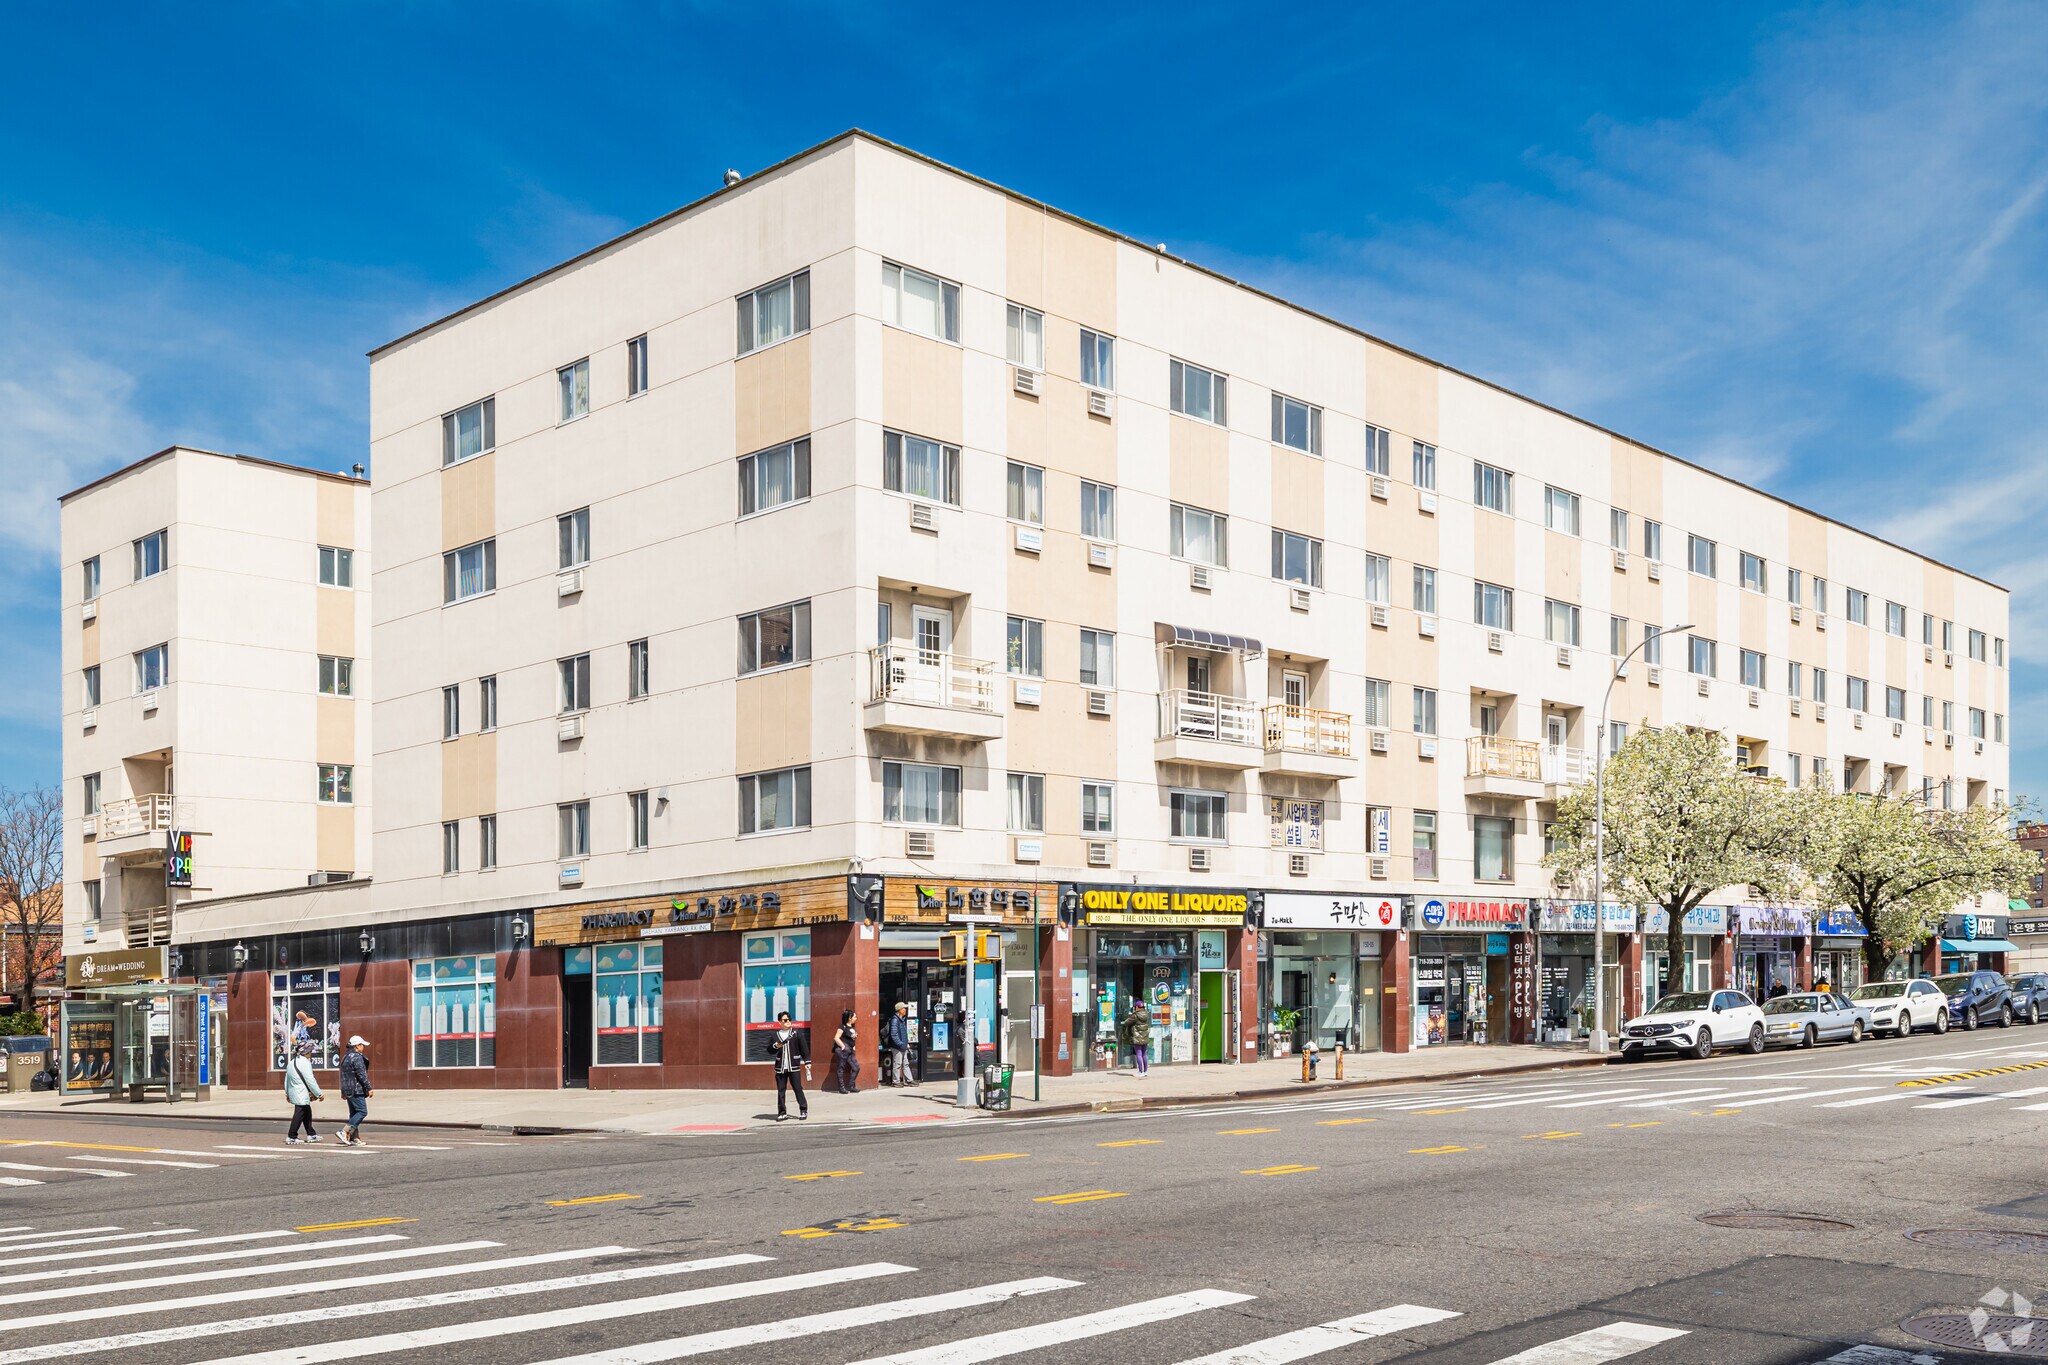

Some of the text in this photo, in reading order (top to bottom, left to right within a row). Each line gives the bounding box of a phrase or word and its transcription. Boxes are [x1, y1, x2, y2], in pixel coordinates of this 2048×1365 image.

[169, 825, 193, 852] VIP
[1378, 811, 1389, 851] 세금
[169, 856, 193, 878] SPA
[697, 892, 781, 917] 대한약국
[947, 887, 1030, 911] 대한약국
[1084, 890, 1247, 912] ONLY ONE LIQUORS
[582, 909, 653, 929] PHARMACY
[1121, 915, 1206, 924] THE ONLY ONE LIQUORS
[1380, 905, 1391, 921] 酒
[1448, 901, 1528, 922] PHARMACY
[1977, 918, 1996, 935] AT&T
[118, 961, 145, 971] WEDDING
[295, 981, 321, 989] AQUARIUM
[301, 974, 314, 982] KHC
[17, 1056, 41, 1065] 3519
